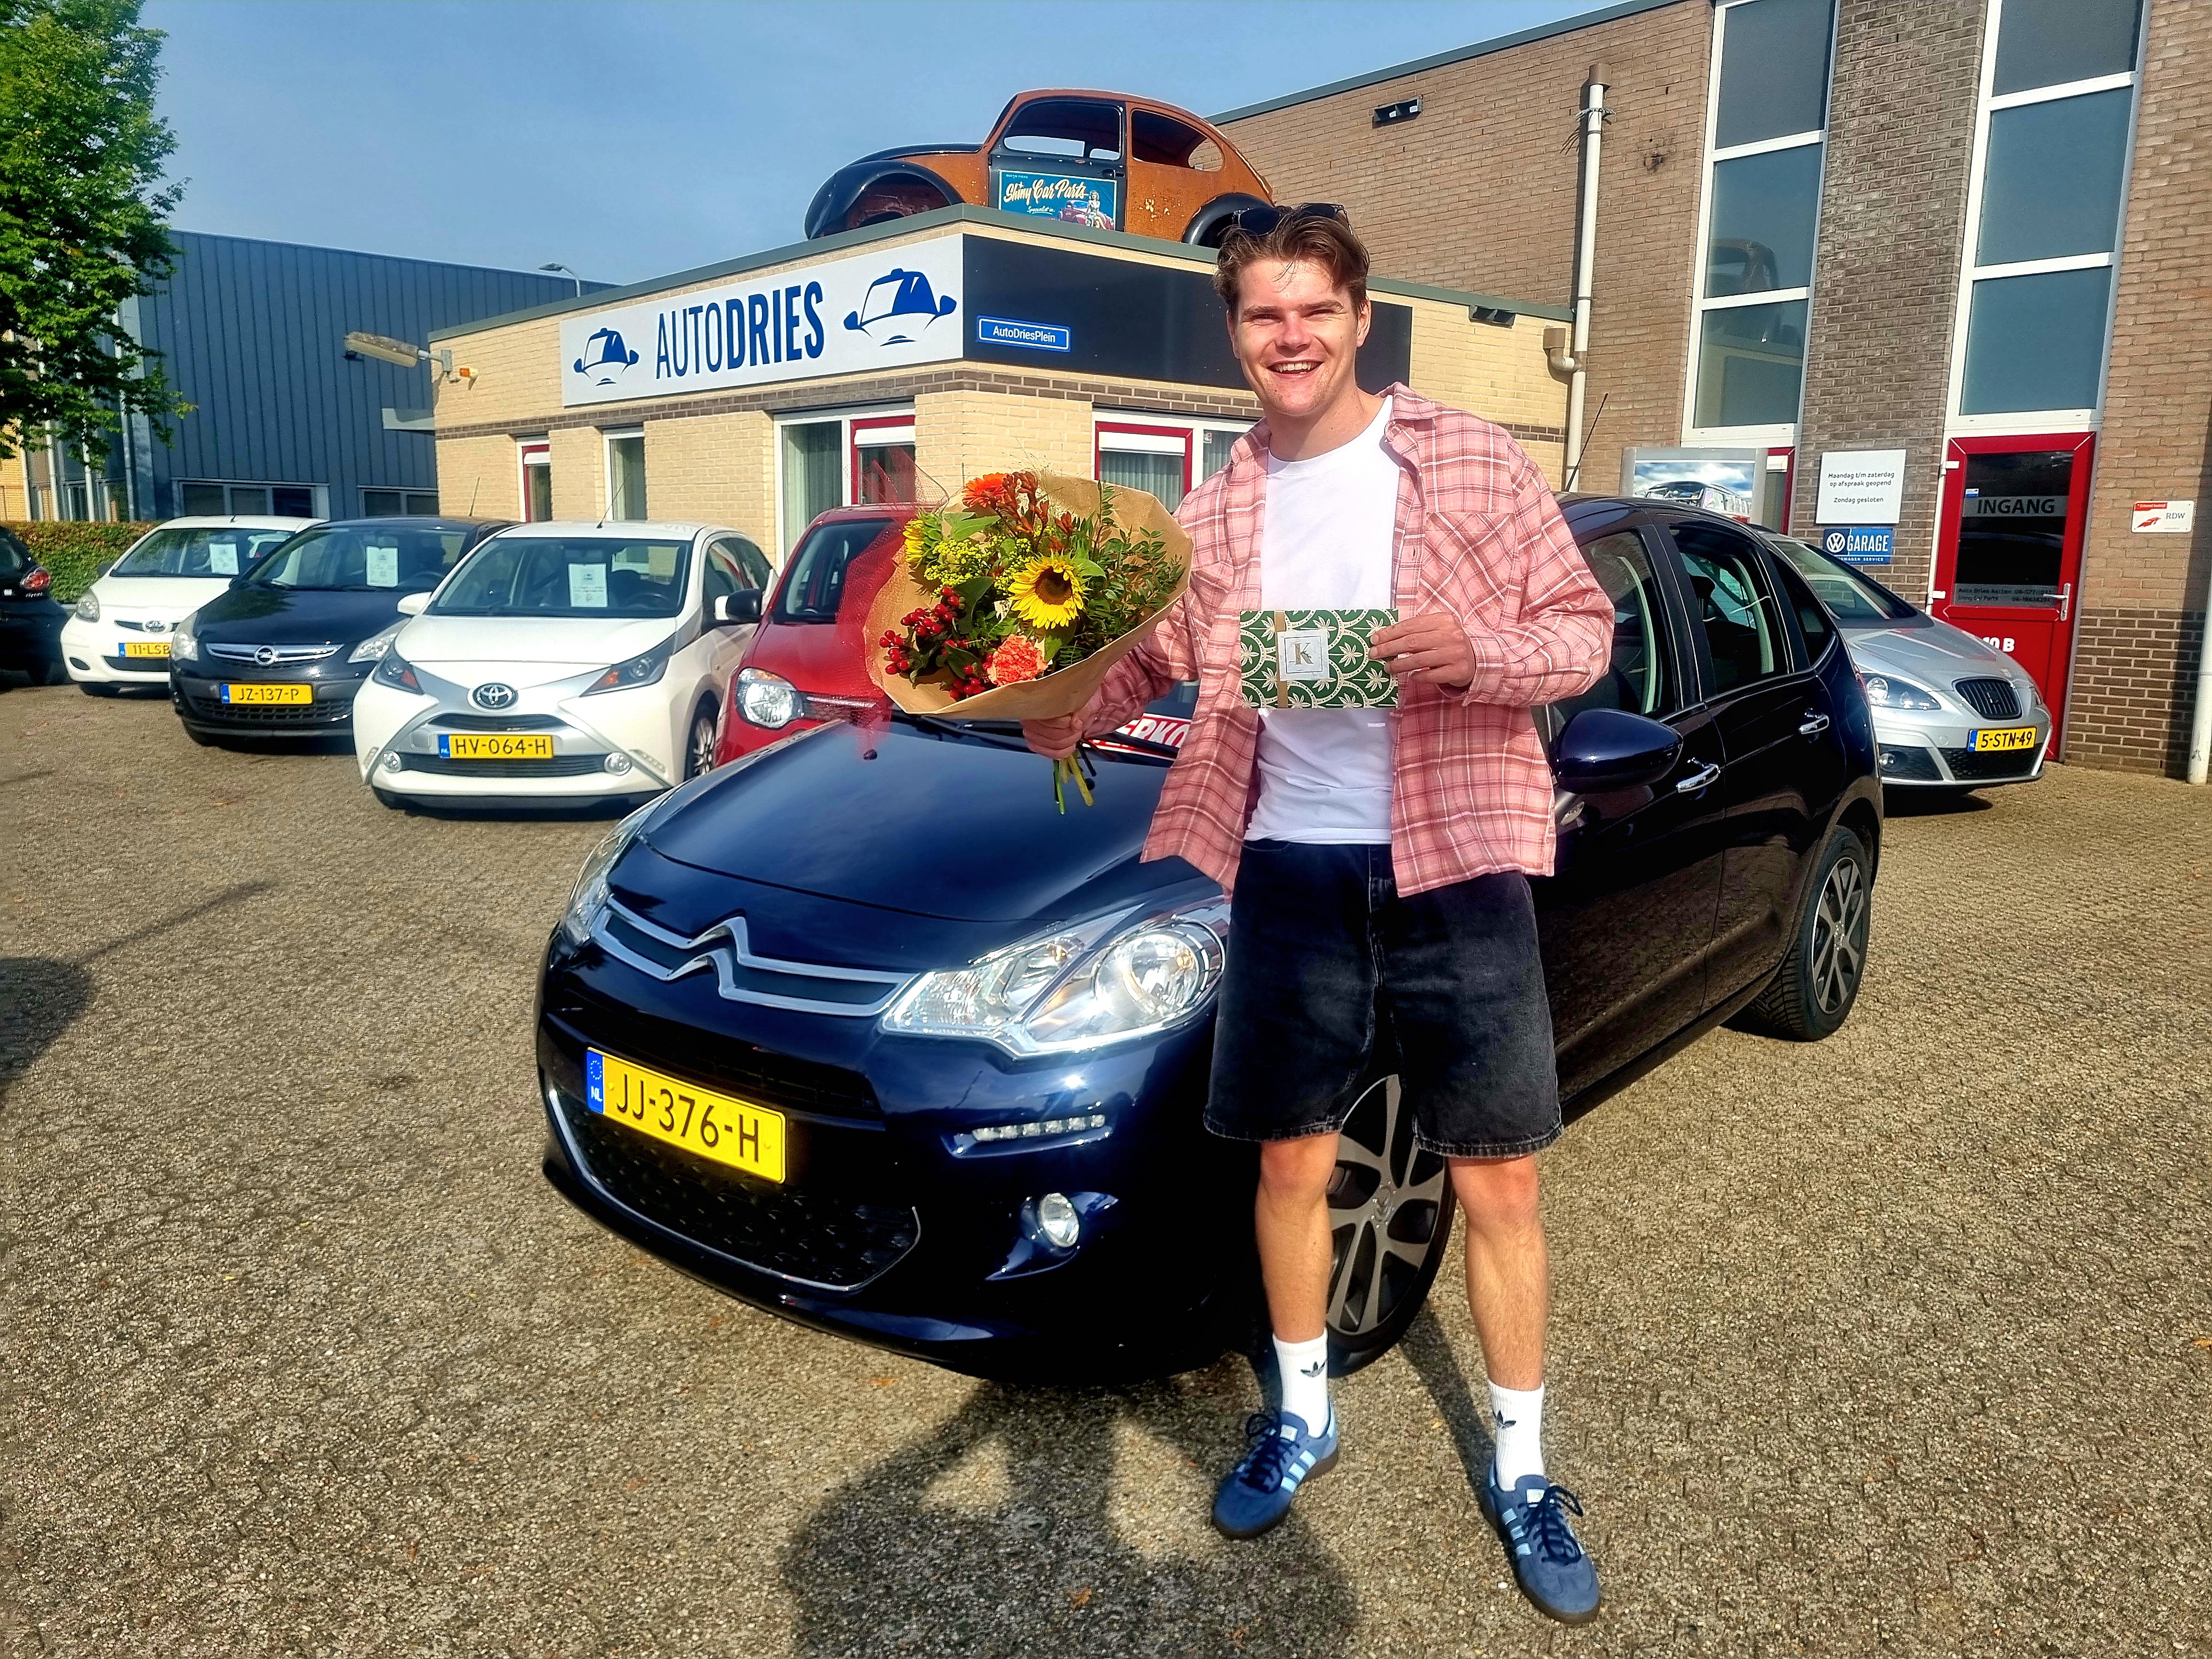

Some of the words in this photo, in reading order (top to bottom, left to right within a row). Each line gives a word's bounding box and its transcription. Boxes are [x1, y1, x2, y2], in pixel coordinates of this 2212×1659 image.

[1003, 182, 1032, 206] Shiny
[1032, 179, 1054, 204] Car
[1055, 179, 1088, 199] Parts
[656, 281, 823, 379] AUTODRIES
[993, 325, 1056, 343] AutoDriesPlein
[1977, 498, 2055, 514] INGANG
[1847, 535, 1889, 552] GARAGE
[2002, 637, 2015, 652] B
[1293, 642, 1314, 665] K
[238, 688, 299, 701] JZ-137-P
[455, 738, 546, 754] HV-064-H
[1981, 731, 2032, 748] 5-STN-49
[590, 1086, 603, 1102] NL
[617, 1073, 759, 1163] JJ-376-H
